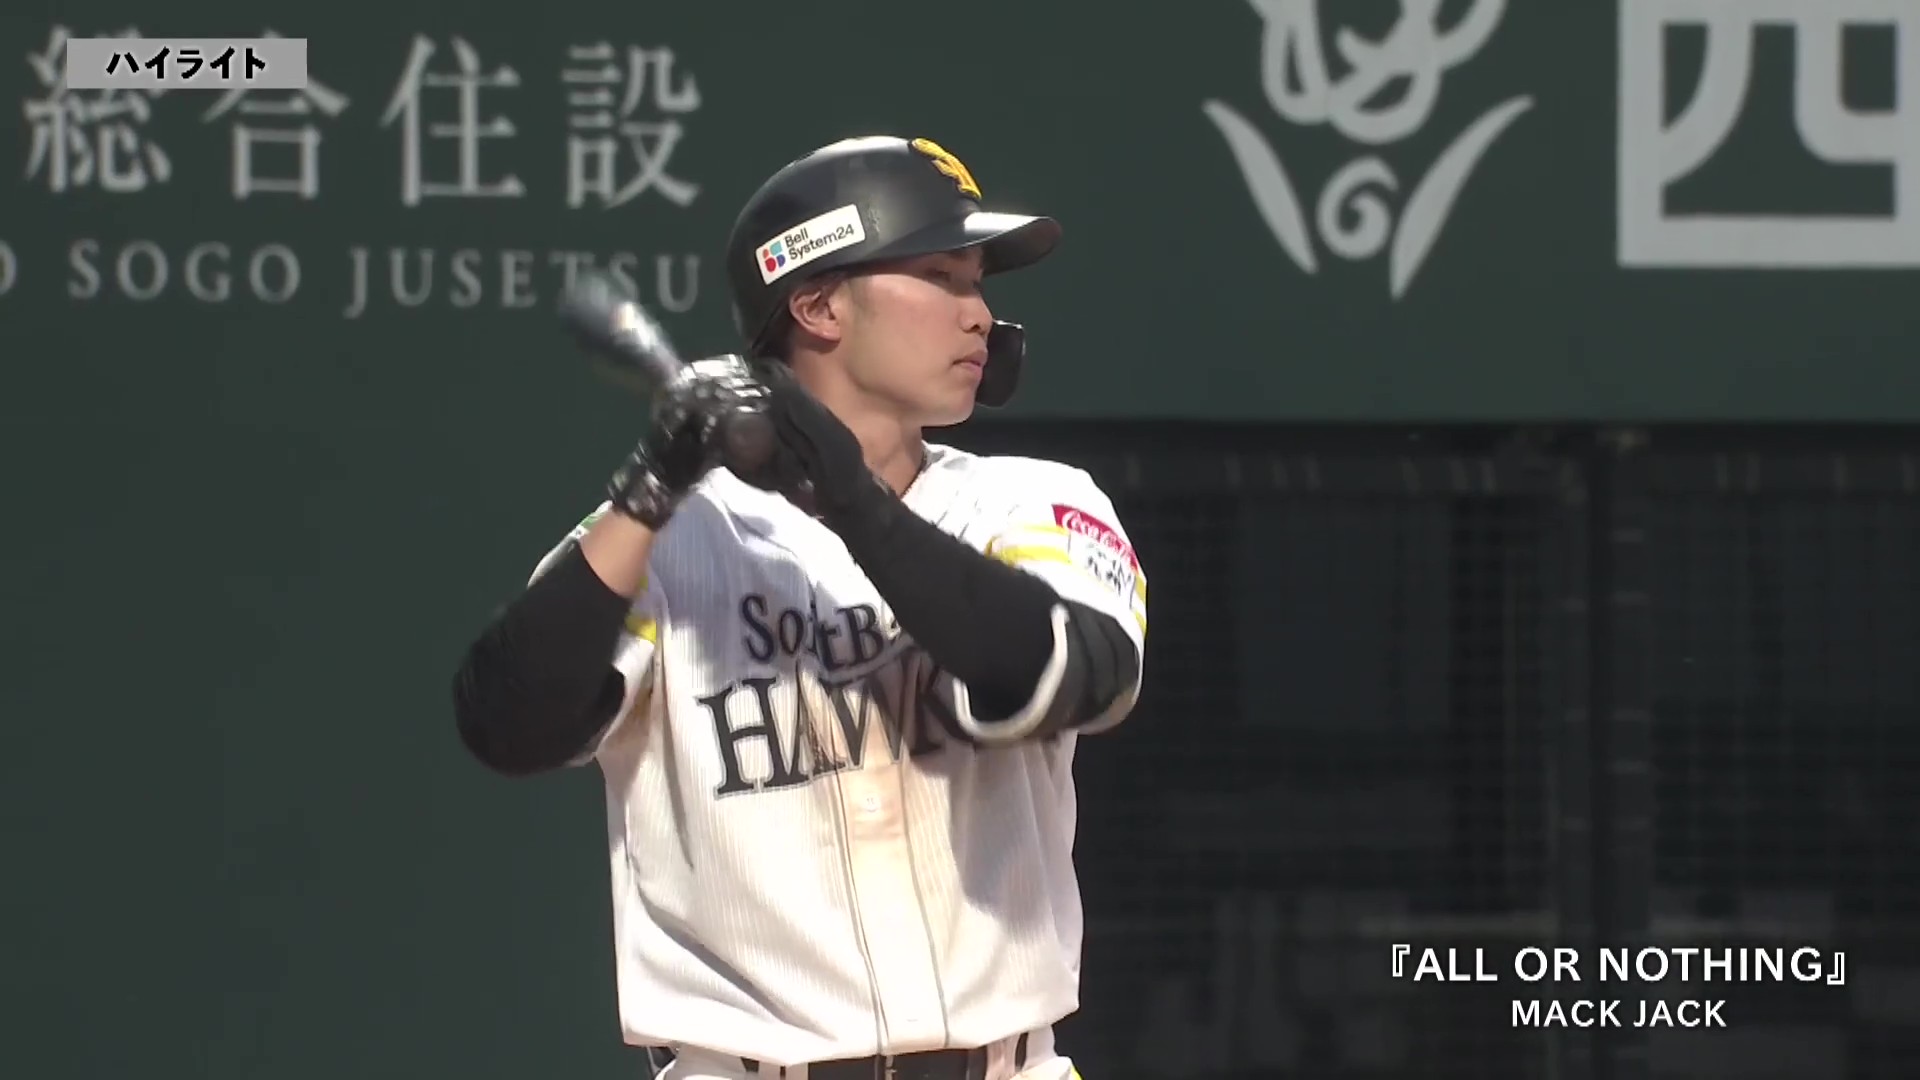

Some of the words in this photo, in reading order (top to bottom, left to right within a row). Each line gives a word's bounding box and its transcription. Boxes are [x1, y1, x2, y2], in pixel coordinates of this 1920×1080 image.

[784, 227, 809, 249] Bell
[788, 223, 855, 261] System24
[68, 238, 302, 304] SOGO
